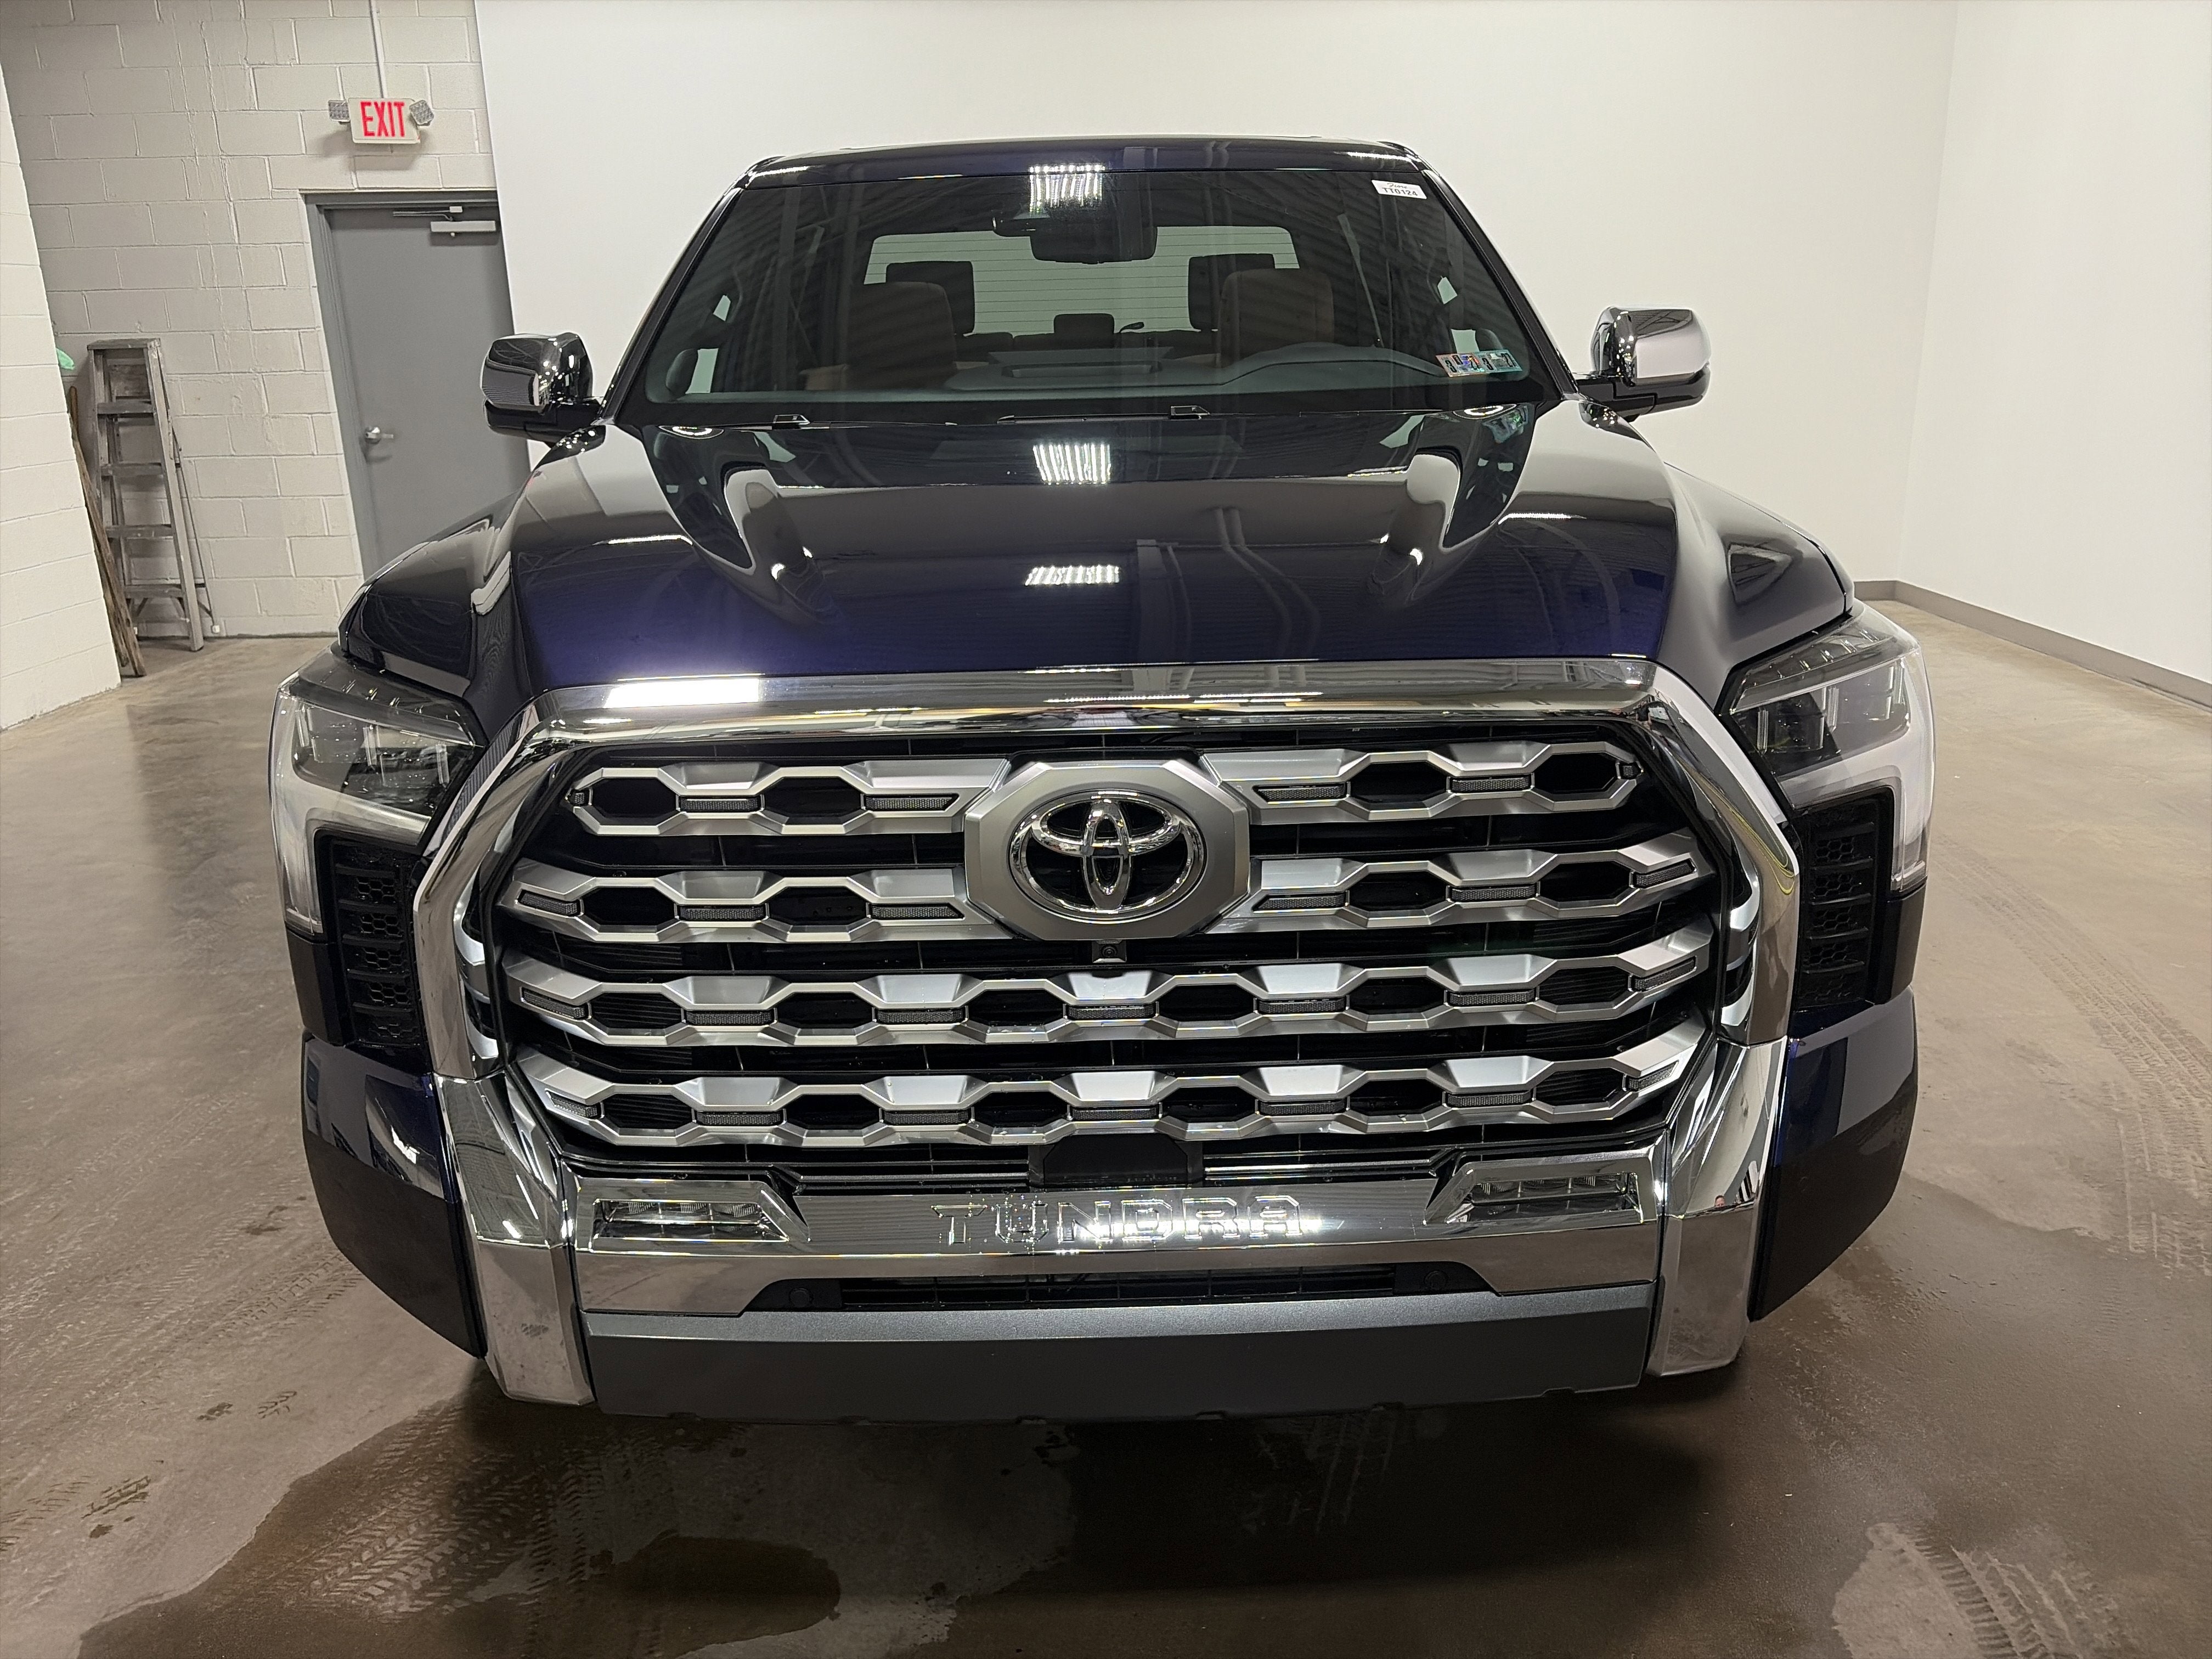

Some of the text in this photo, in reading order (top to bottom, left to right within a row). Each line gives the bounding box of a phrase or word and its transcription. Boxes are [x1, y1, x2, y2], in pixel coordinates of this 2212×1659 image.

[360, 100, 405, 137] EXIT
[1482, 358, 1494, 370] 3
[931, 1195, 1303, 1243] TUNDRA
